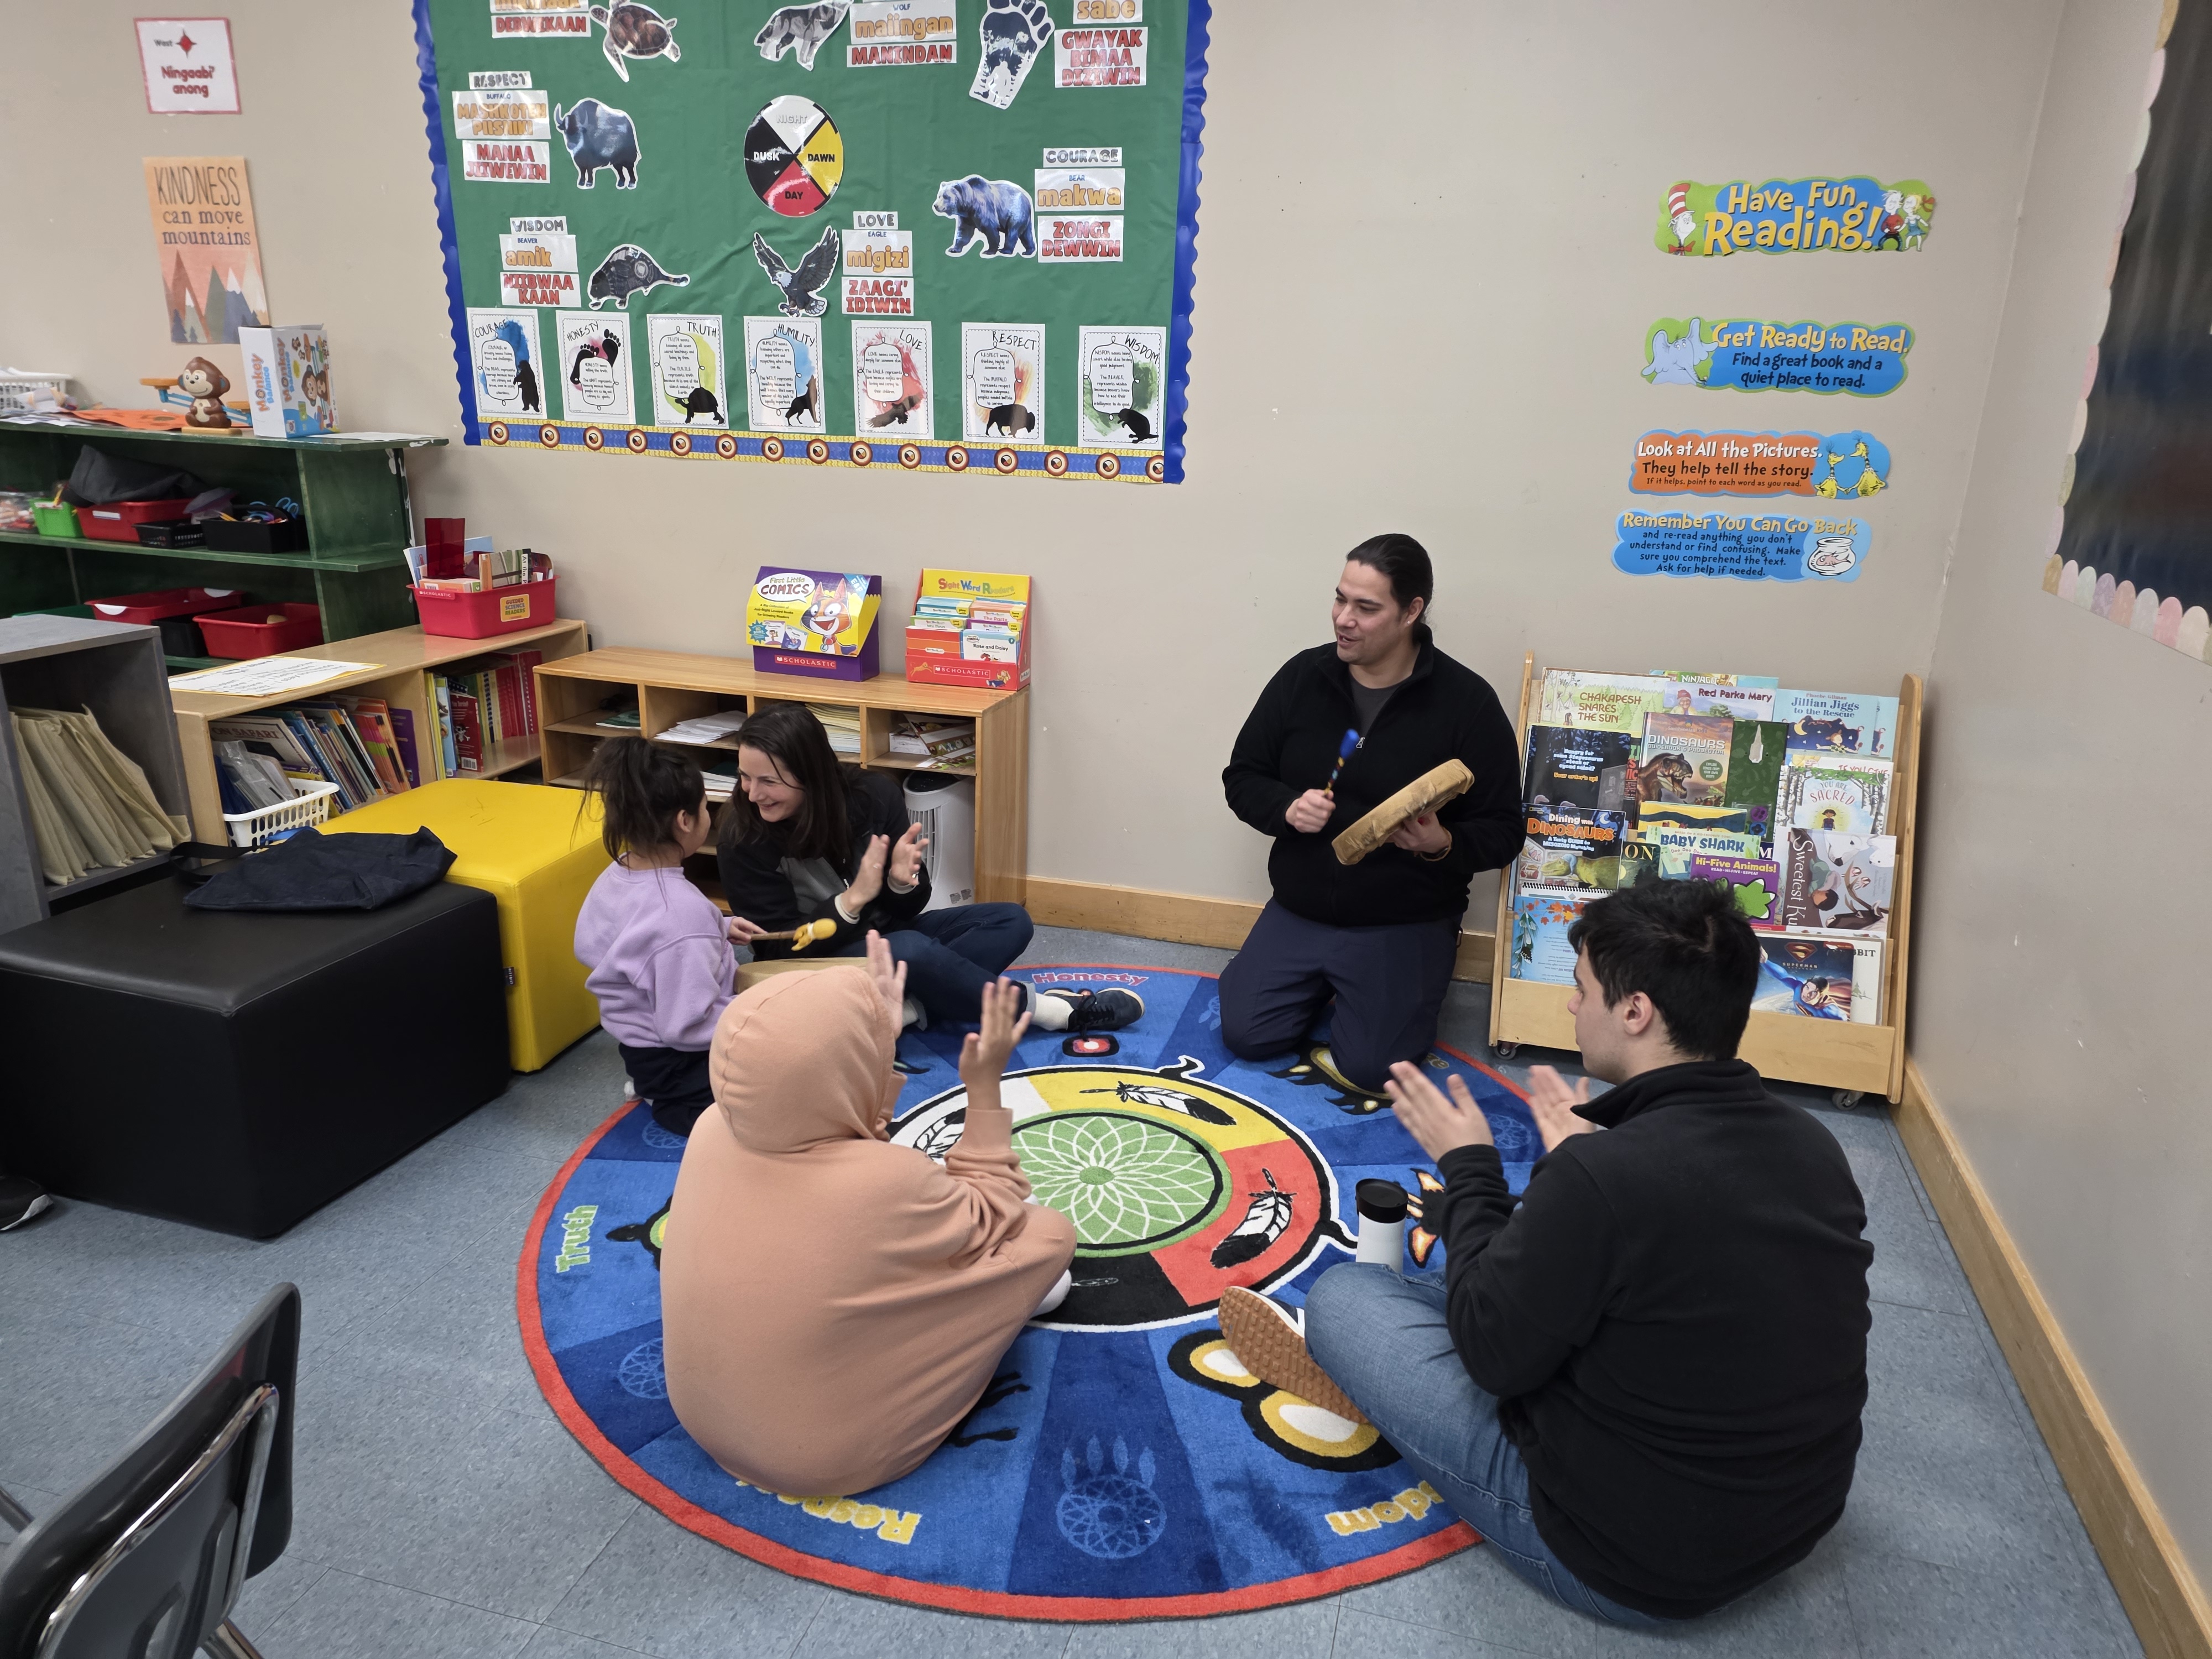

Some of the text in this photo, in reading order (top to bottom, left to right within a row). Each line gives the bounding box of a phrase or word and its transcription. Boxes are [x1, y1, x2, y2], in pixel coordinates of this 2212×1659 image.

[855, 13, 953, 40] maiingan
[1062, 29, 1142, 49] GWAYAK
[851, 44, 952, 65] MANINDAN
[1070, 48, 1133, 67] BIMAA
[1062, 66, 1141, 86] DIZIWIN
[172, 84, 209, 98] anong
[776, 114, 807, 124] NIGHT
[476, 144, 535, 163] MANAA
[753, 151, 780, 161] DUSK
[807, 153, 836, 163] DAWN
[1046, 149, 1119, 163] COURAGE
[153, 166, 241, 206] KINDNESS
[785, 191, 803, 200] DAY
[1037, 184, 1121, 207] makwa
[1726, 181, 1856, 215] Have Fun
[163, 210, 244, 224] can move
[512, 219, 564, 232] WISDOM
[858, 213, 895, 227] LOVE
[161, 226, 251, 245] mountains
[1053, 221, 1110, 238] ZONGI
[1703, 201, 1886, 257] Reading!
[505, 246, 552, 267] amik
[1042, 239, 1120, 257] DEWWIN
[846, 244, 910, 273] migizi
[503, 273, 575, 290] NIIBWAA
[848, 280, 908, 296] ZAAGI'
[518, 289, 561, 305] KAAN
[846, 296, 911, 314] IDIWIN
[474, 319, 509, 338] COURAGE
[566, 321, 599, 342] HONESTY
[686, 321, 717, 338] TRUTH
[778, 323, 816, 347] HUMILITY
[899, 329, 923, 350] LOVE
[992, 331, 1037, 351] RESPECT
[1712, 322, 1910, 353] Get Ready to Read.
[1125, 335, 1159, 364] WISDOM
[1732, 352, 1882, 371] Find a great book and a
[251, 352, 270, 412] Monkey
[263, 366, 275, 404] Balance
[1740, 371, 1866, 388] quiet place to read.
[1637, 440, 1823, 458] Look at All the Pictures.
[1642, 460, 1814, 480] They help tell the story.
[1687, 478, 1707, 487] point
[1623, 512, 1858, 536] Remember You Can Go Back
[1642, 530, 1793, 545] and re-read anything you don't
[1630, 541, 1682, 551] understand
[1697, 542, 1718, 552] find
[1722, 544, 1770, 557] confusing.
[1776, 547, 1801, 555] Make
[1662, 554, 1680, 563] you
[1682, 553, 1741, 565] comprehend
[1744, 555, 1764, 565] the
[1764, 556, 1786, 566] text.
[1656, 563, 1766, 576] Ask for help if needed.
[760, 584, 810, 595] COMICS
[938, 578, 1015, 594] Sight Word Readers
[783, 656, 836, 668] SCHOLASTIC
[941, 667, 989, 676] SCHOLASTIC
[1579, 692, 1642, 705] CHAKAPESH
[1698, 688, 1772, 703] Red Parka Mary
[1578, 702, 1617, 713] SNARES
[1791, 697, 1860, 712] Jillian Jiggs
[1806, 707, 1821, 716] the
[1823, 709, 1855, 718] Rescue
[1577, 712, 1619, 723] THE SUN
[231, 728, 280, 739] SAFARI
[1647, 734, 1725, 750] DINOSAURS
[1820, 781, 1834, 789] YOU
[1809, 789, 1855, 806] SACRED
[1548, 813, 1580, 825] Dining
[1527, 817, 1615, 842] DINOSAURS
[1660, 834, 1745, 853] BABY SHARK
[1695, 857, 1777, 873] Hi-Five Animals!
[1791, 834, 1814, 902] Sweetest
[1031, 972, 1150, 987] Honesty
[556, 1204, 599, 1273] Truth
